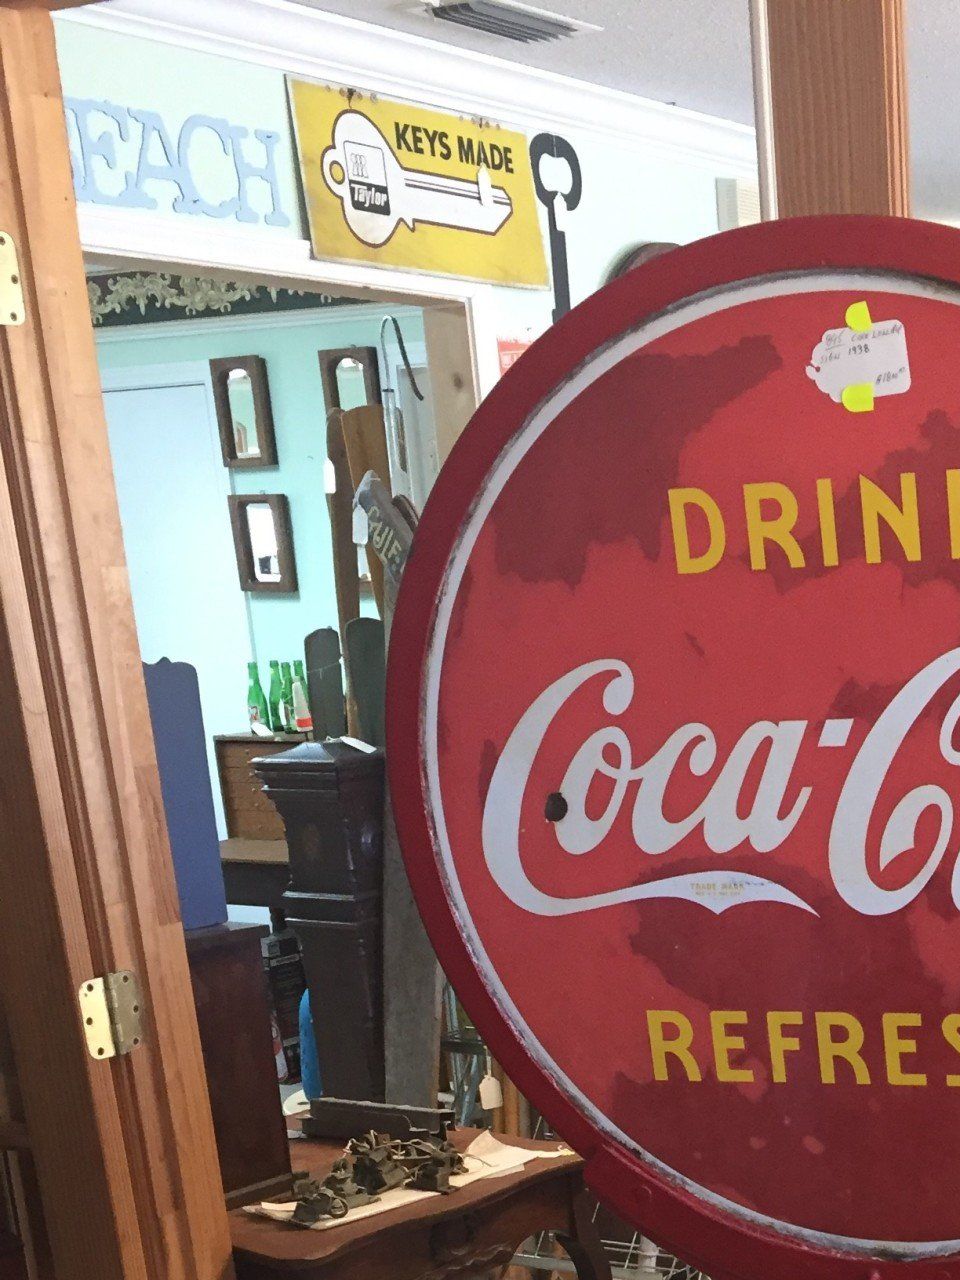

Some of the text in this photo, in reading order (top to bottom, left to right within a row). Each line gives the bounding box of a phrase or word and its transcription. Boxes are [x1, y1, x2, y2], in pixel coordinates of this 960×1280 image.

[64, 97, 290, 227] EACH
[394, 121, 514, 174] KEYS MADE
[350, 183, 388, 208] Taylor
[848, 343, 870, 356] 1938
